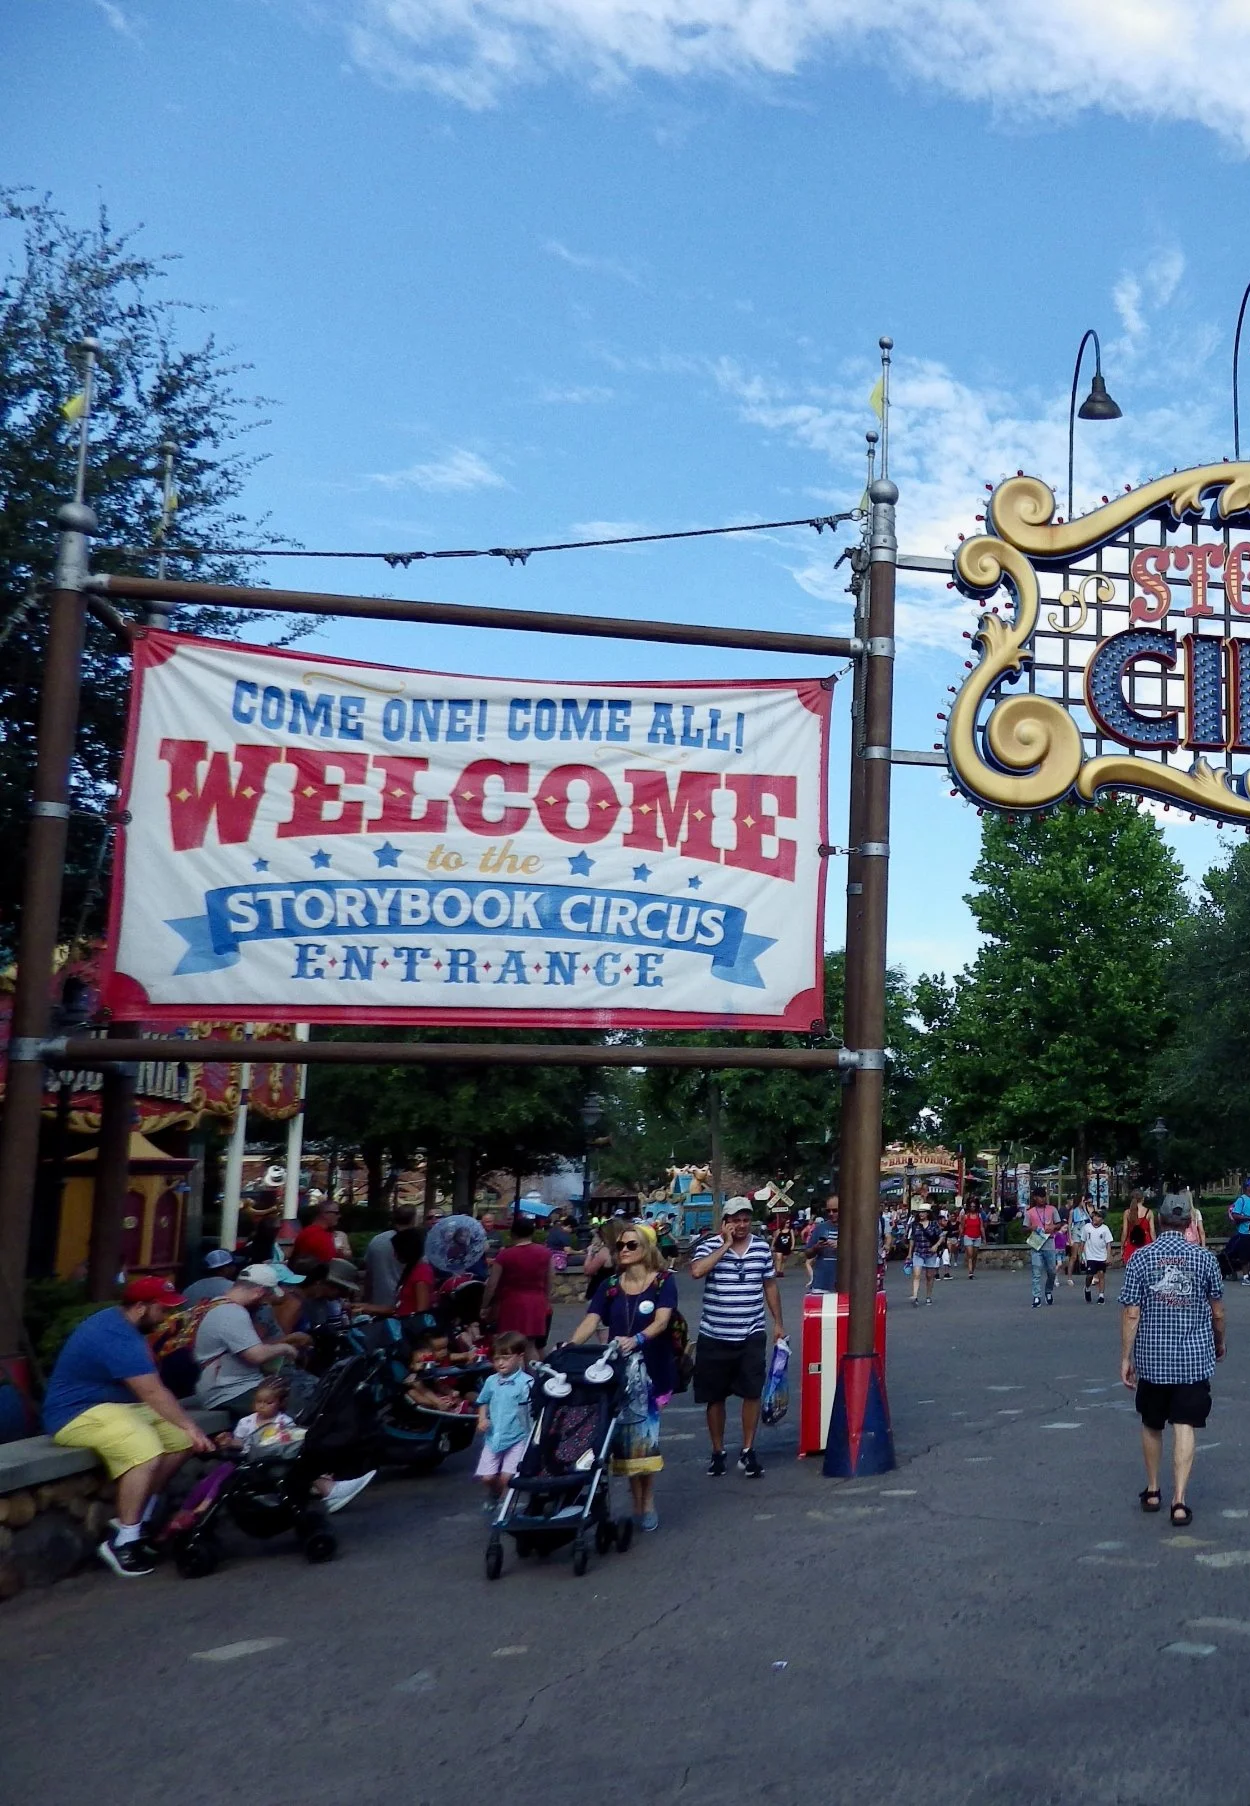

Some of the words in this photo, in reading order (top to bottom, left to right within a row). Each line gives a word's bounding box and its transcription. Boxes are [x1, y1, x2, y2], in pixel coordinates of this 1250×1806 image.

[232, 679, 365, 742] COME
[382, 698, 488, 743] ONE!
[507, 697, 632, 743] COME
[646, 702, 745, 754] ALL!
[159, 738, 798, 883] WELCOME
[427, 843, 466, 873] to
[479, 838, 543, 876] the
[228, 886, 545, 935] STORYBOOK
[561, 892, 726, 947] CIRCUS
[290, 942, 665, 988] ENTRANCE
[888, 1154, 955, 1167] BARSTORMER
